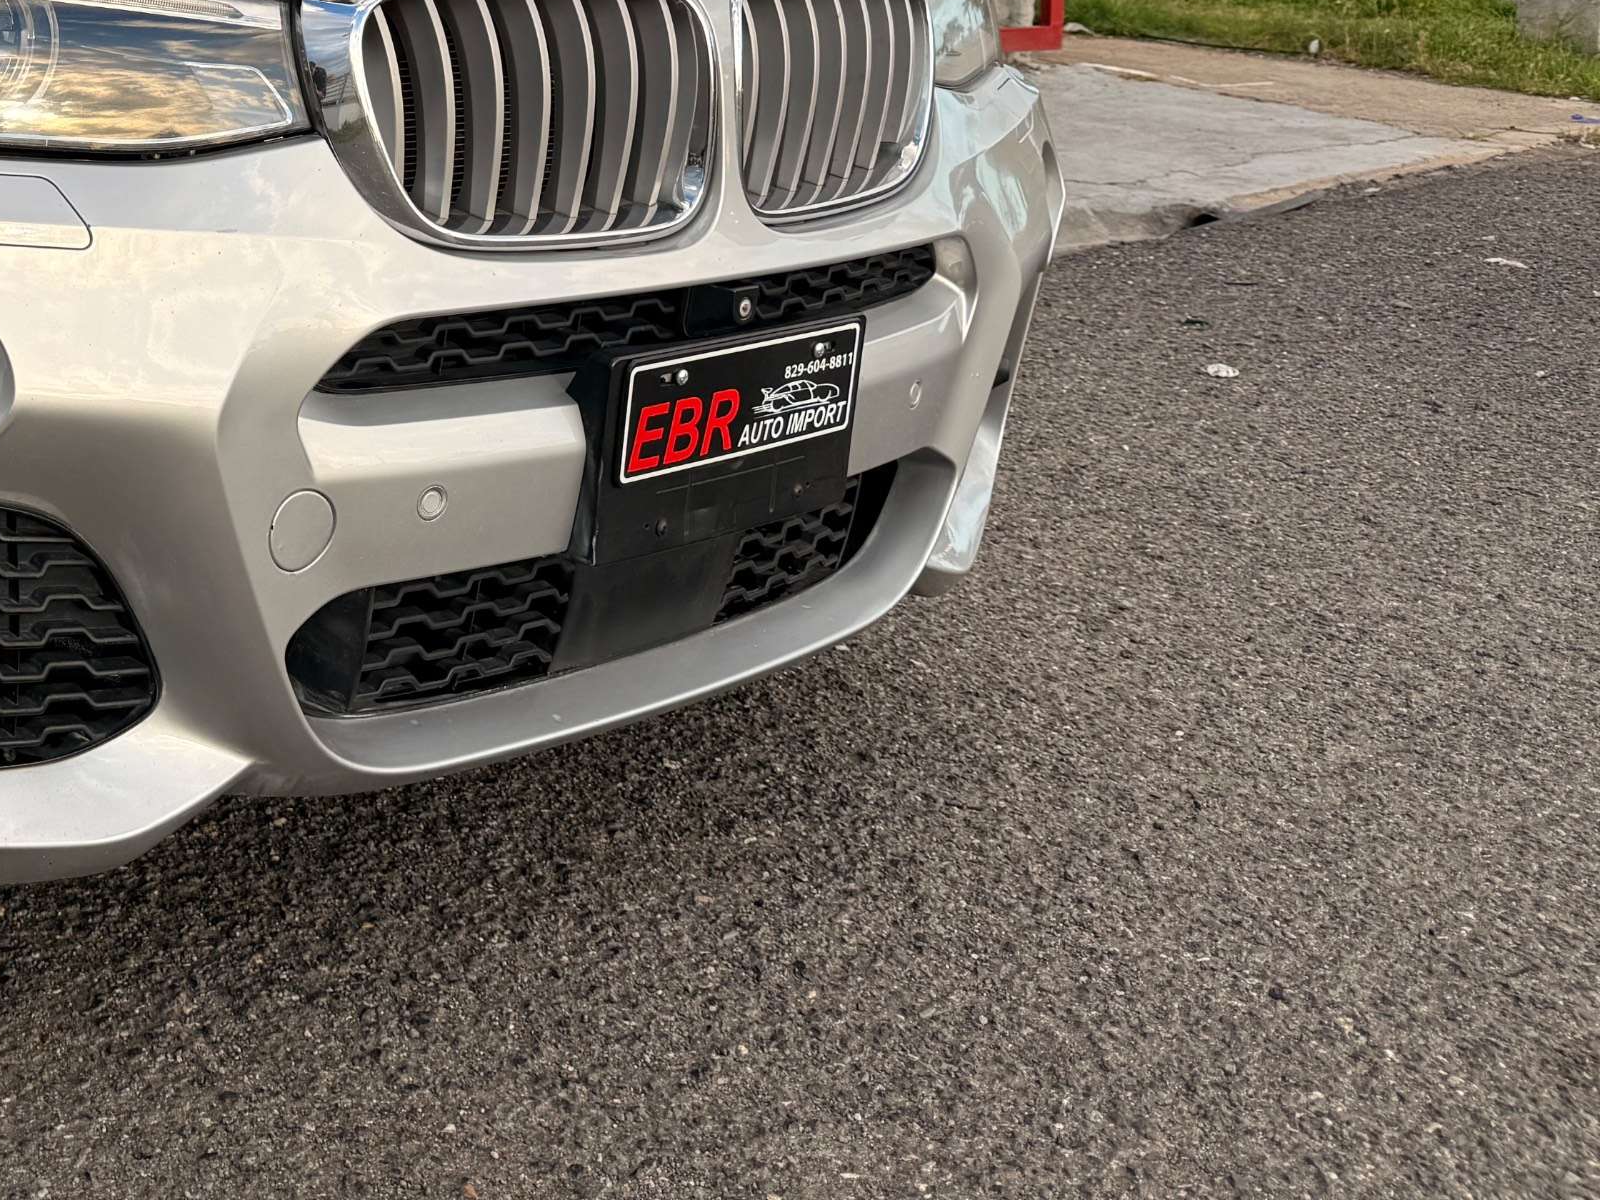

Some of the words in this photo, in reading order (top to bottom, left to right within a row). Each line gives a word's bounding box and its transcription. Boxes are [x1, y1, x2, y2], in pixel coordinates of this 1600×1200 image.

[784, 351, 853, 379] 829-604-8811
[627, 388, 740, 473] EBR
[737, 418, 785, 448] AUTO
[785, 400, 848, 435] IMPORT
